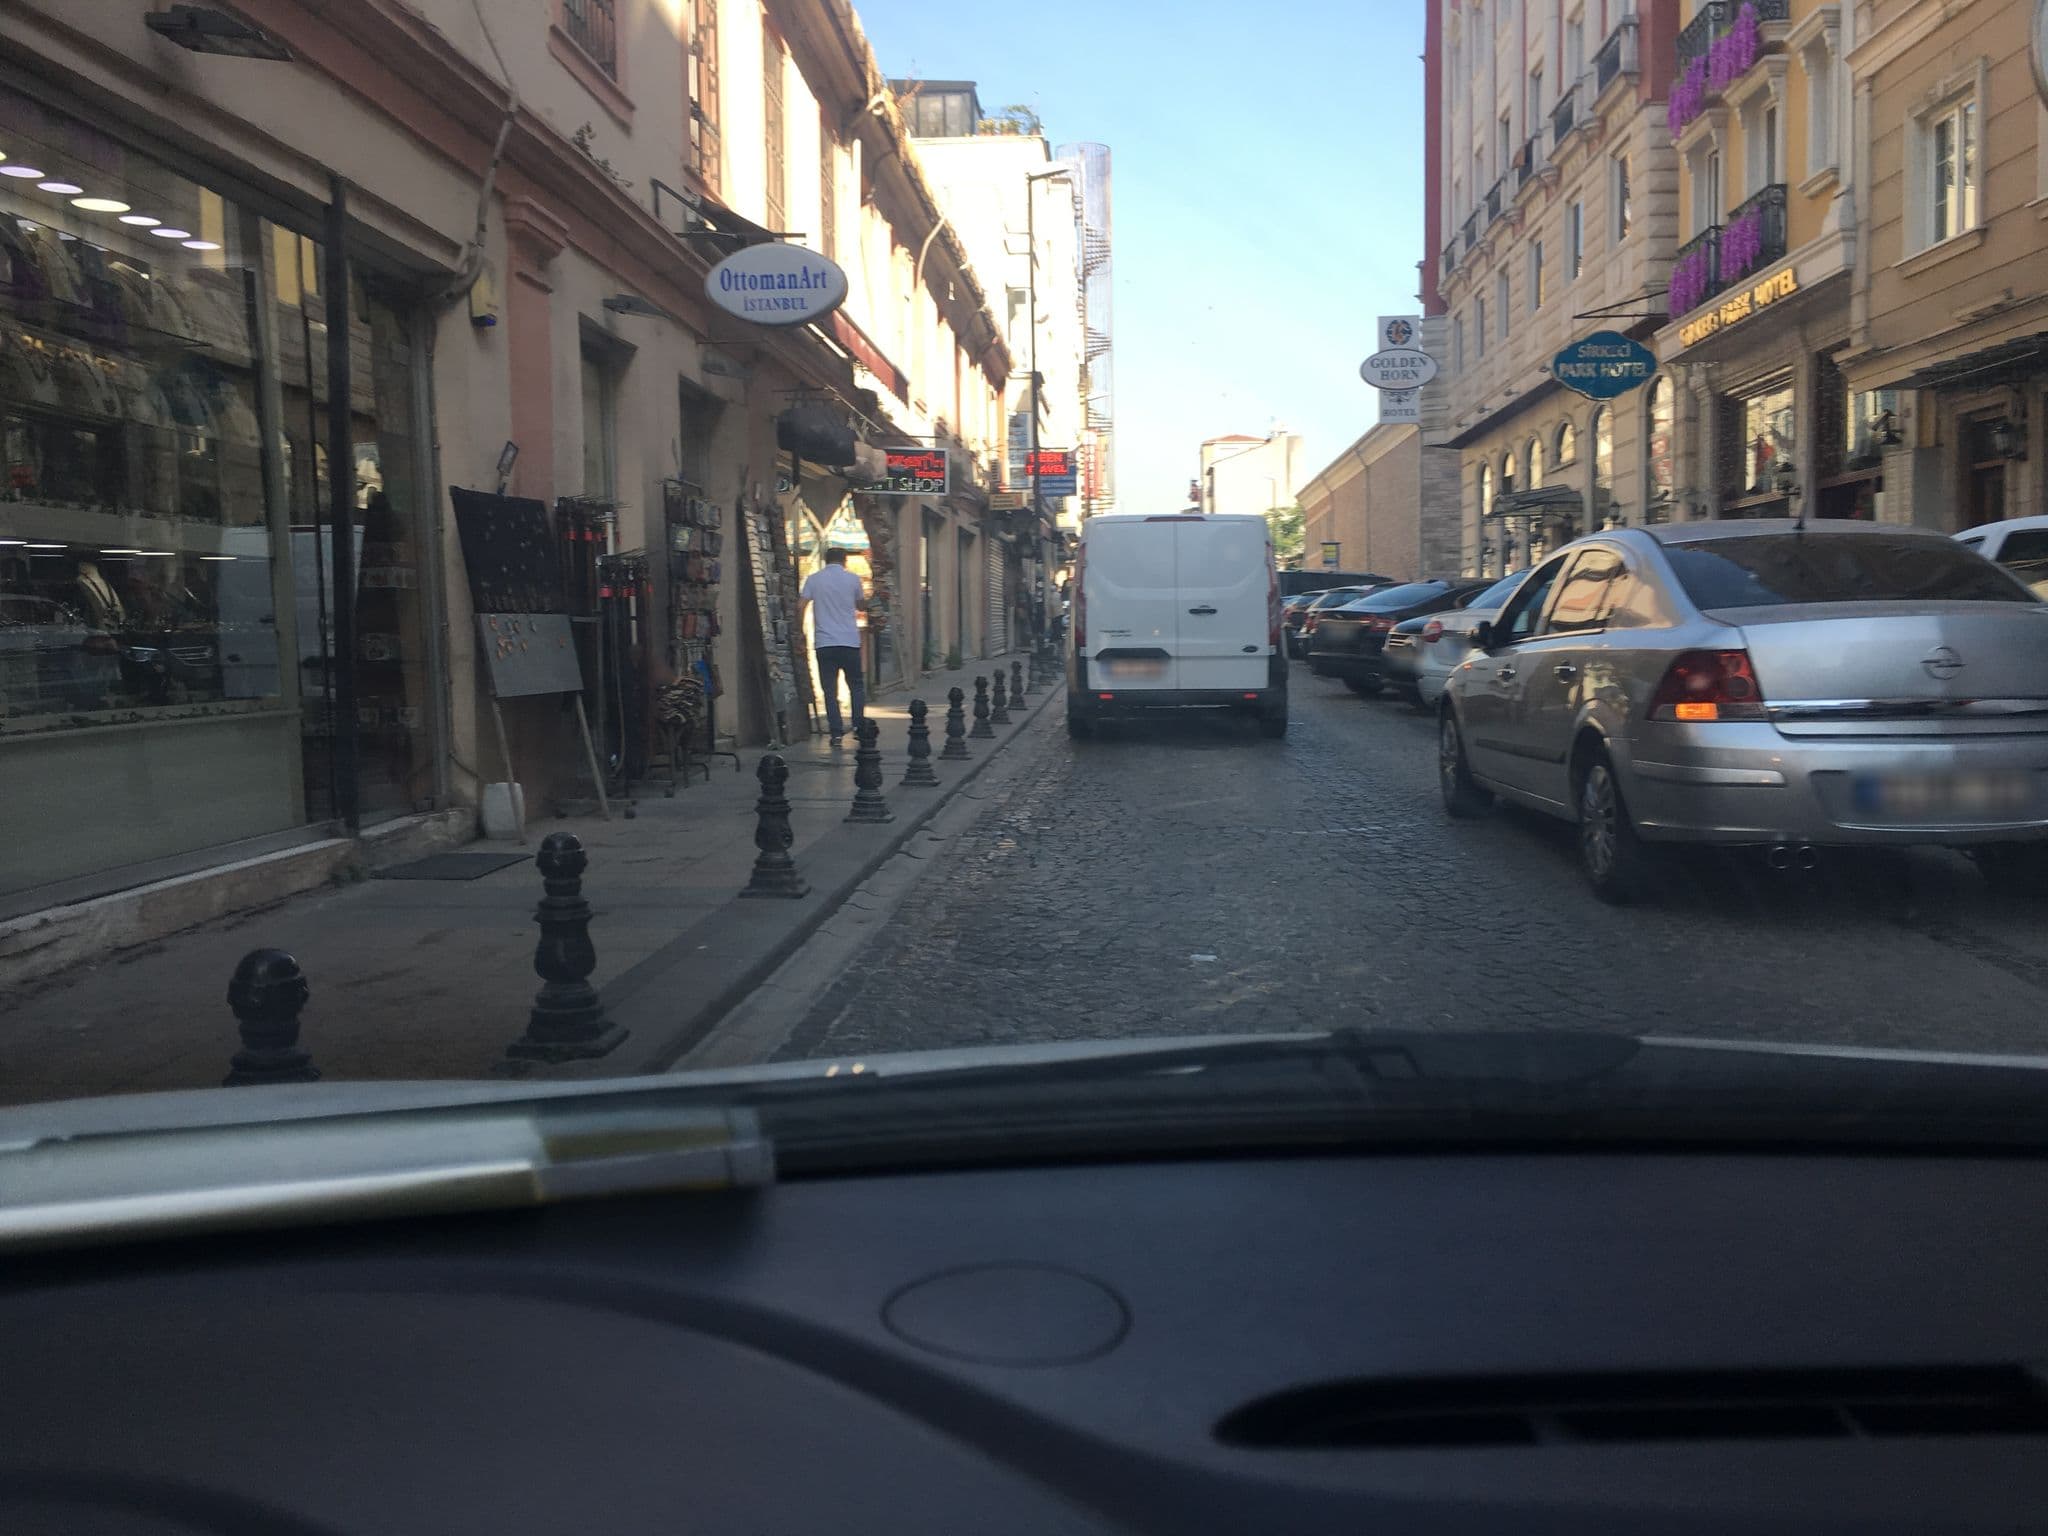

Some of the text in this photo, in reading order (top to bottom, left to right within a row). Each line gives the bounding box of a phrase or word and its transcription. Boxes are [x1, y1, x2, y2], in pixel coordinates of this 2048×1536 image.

[720, 266, 828, 292] OttomanArt
[1370, 358, 1428, 369] GOLDEN
[1380, 370, 1420, 381] HORN
[1600, 362, 1649, 378] HOTEL
[1383, 409, 1417, 417] HOTEL
[1026, 464, 1068, 474] TAVEL
[899, 477, 944, 491] SHOP
